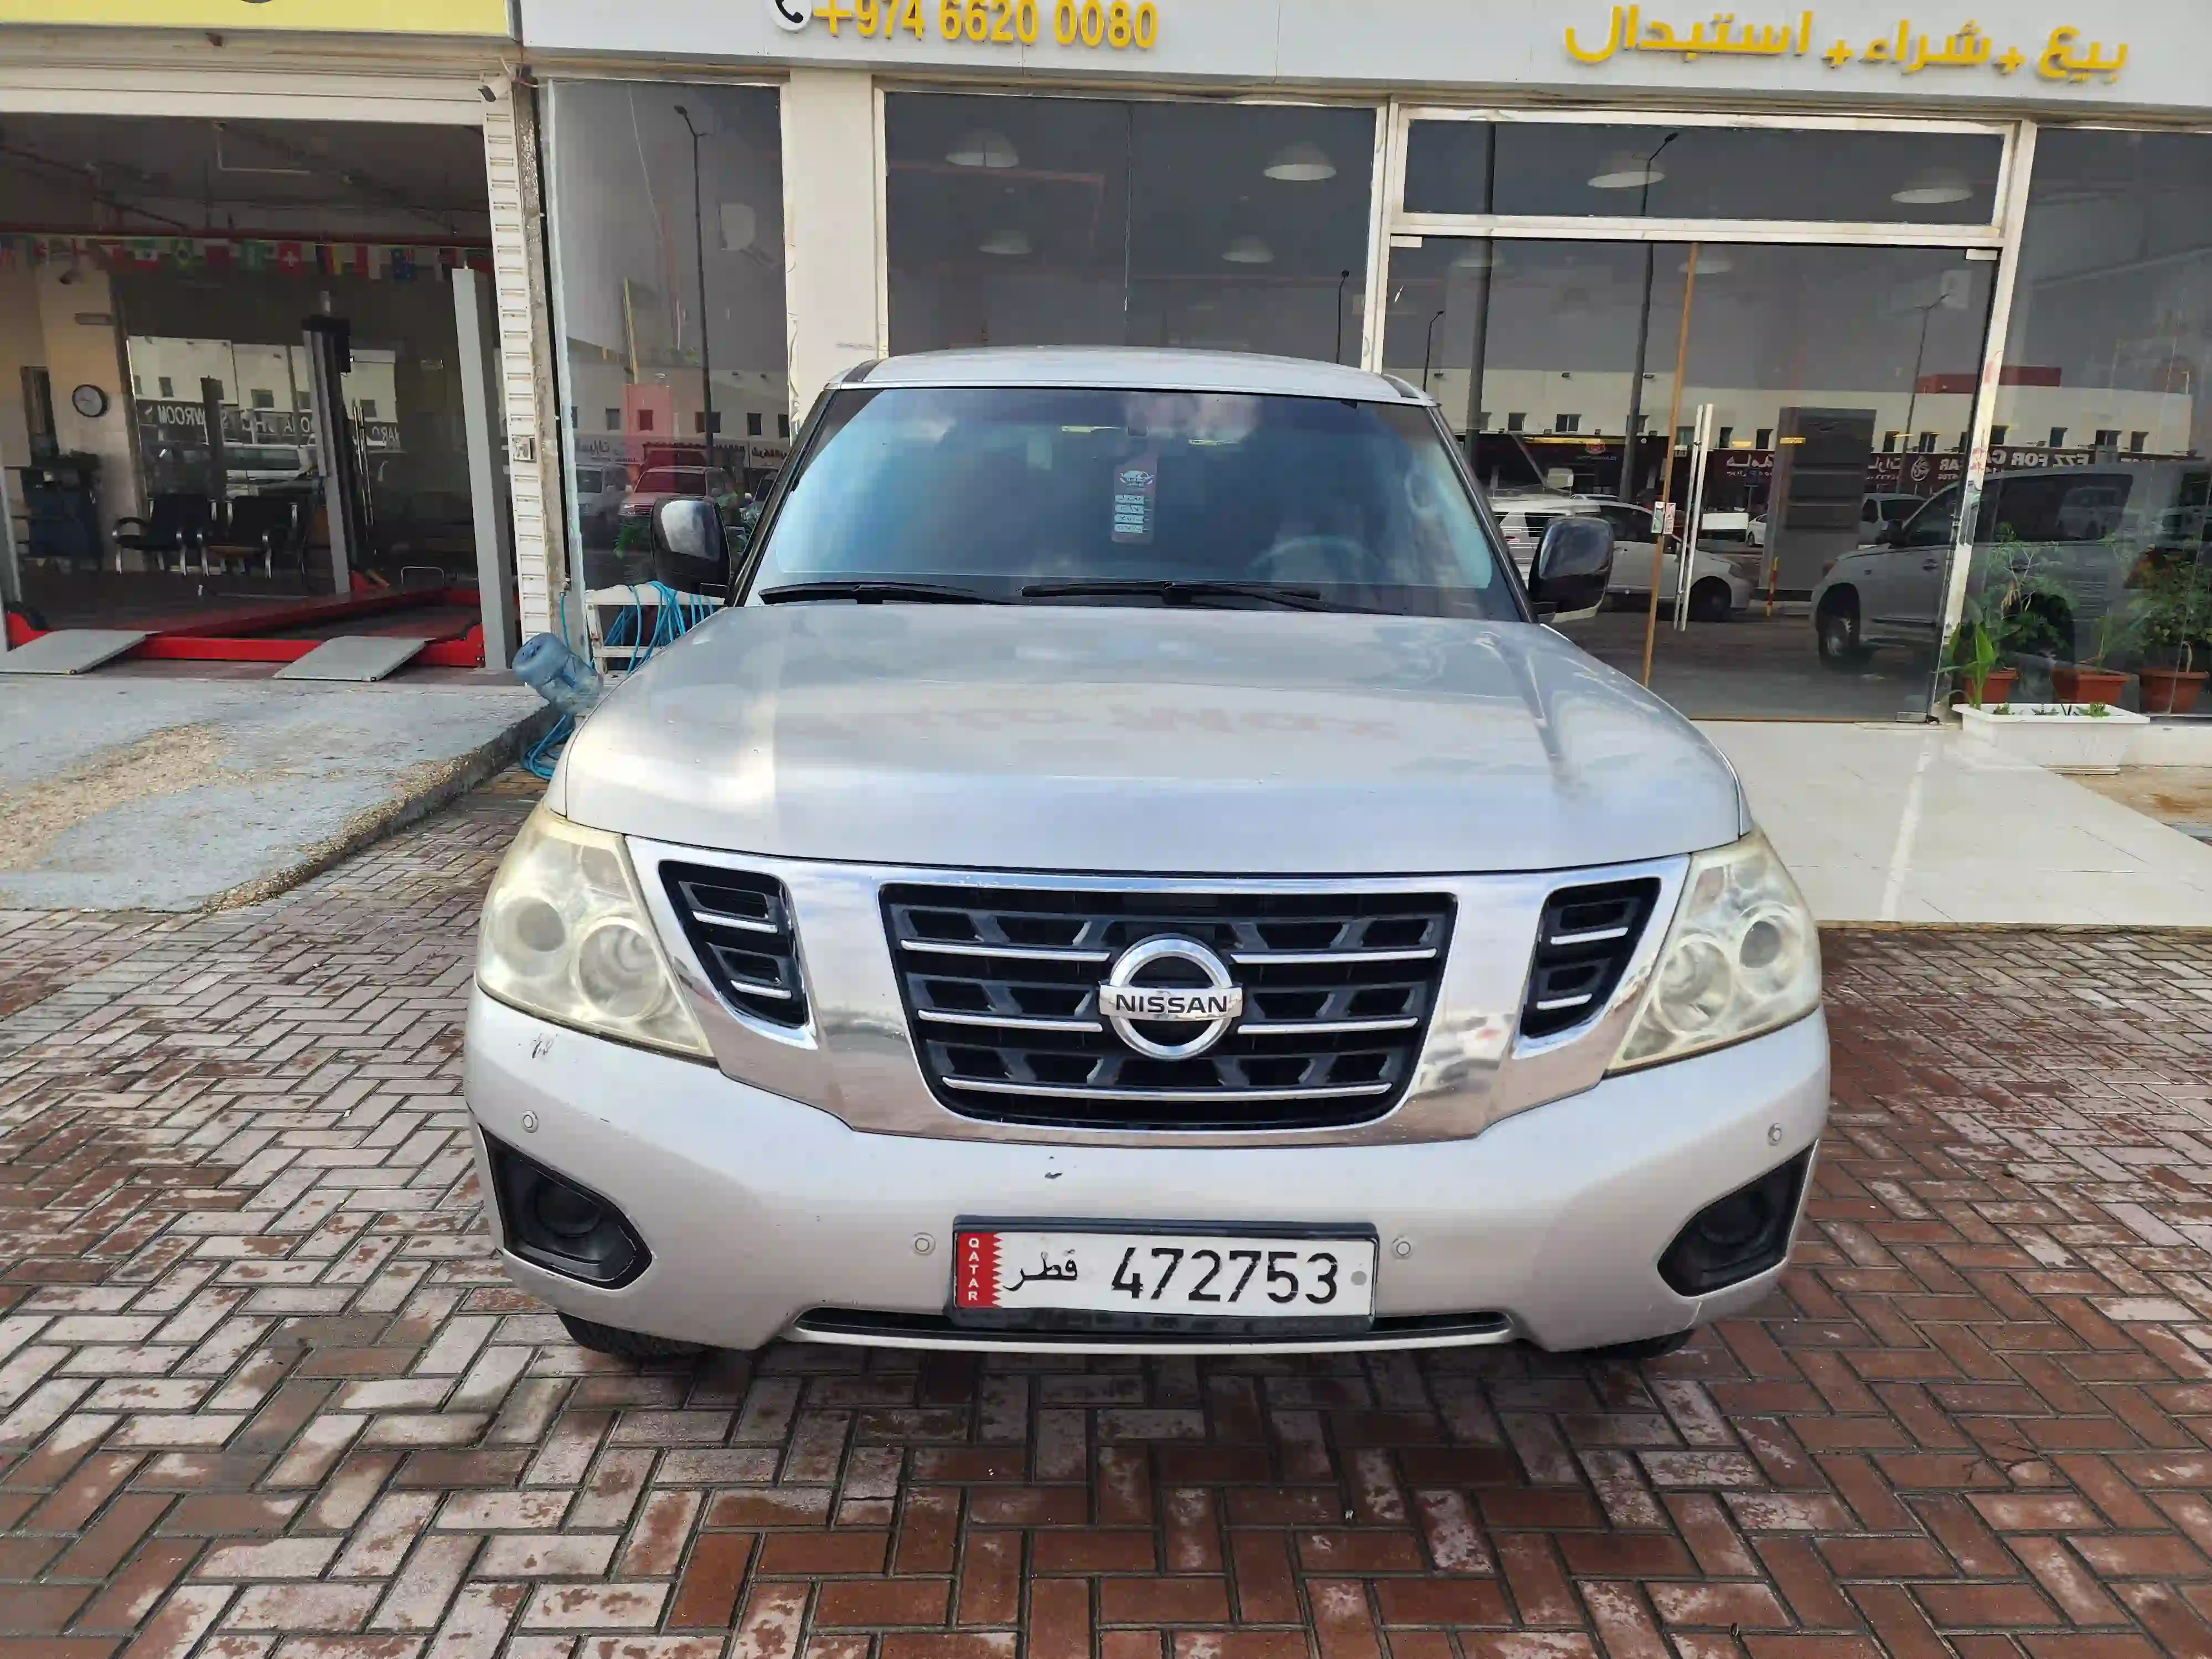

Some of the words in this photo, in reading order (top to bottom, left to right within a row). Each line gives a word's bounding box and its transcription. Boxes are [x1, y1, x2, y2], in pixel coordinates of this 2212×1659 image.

[939, 0, 1038, 44] 6620
[1054, 0, 1158, 49] 0080
[1565, 4, 1813, 62] استبدال
[1863, 19, 1991, 74] شراء
[2038, 25, 2128, 84] بيع
[1115, 994, 1227, 1014] NISSAN
[968, 1237, 980, 1301] QATAR
[1002, 1248, 1078, 1292] قطر
[1111, 1246, 1338, 1305] 472753
